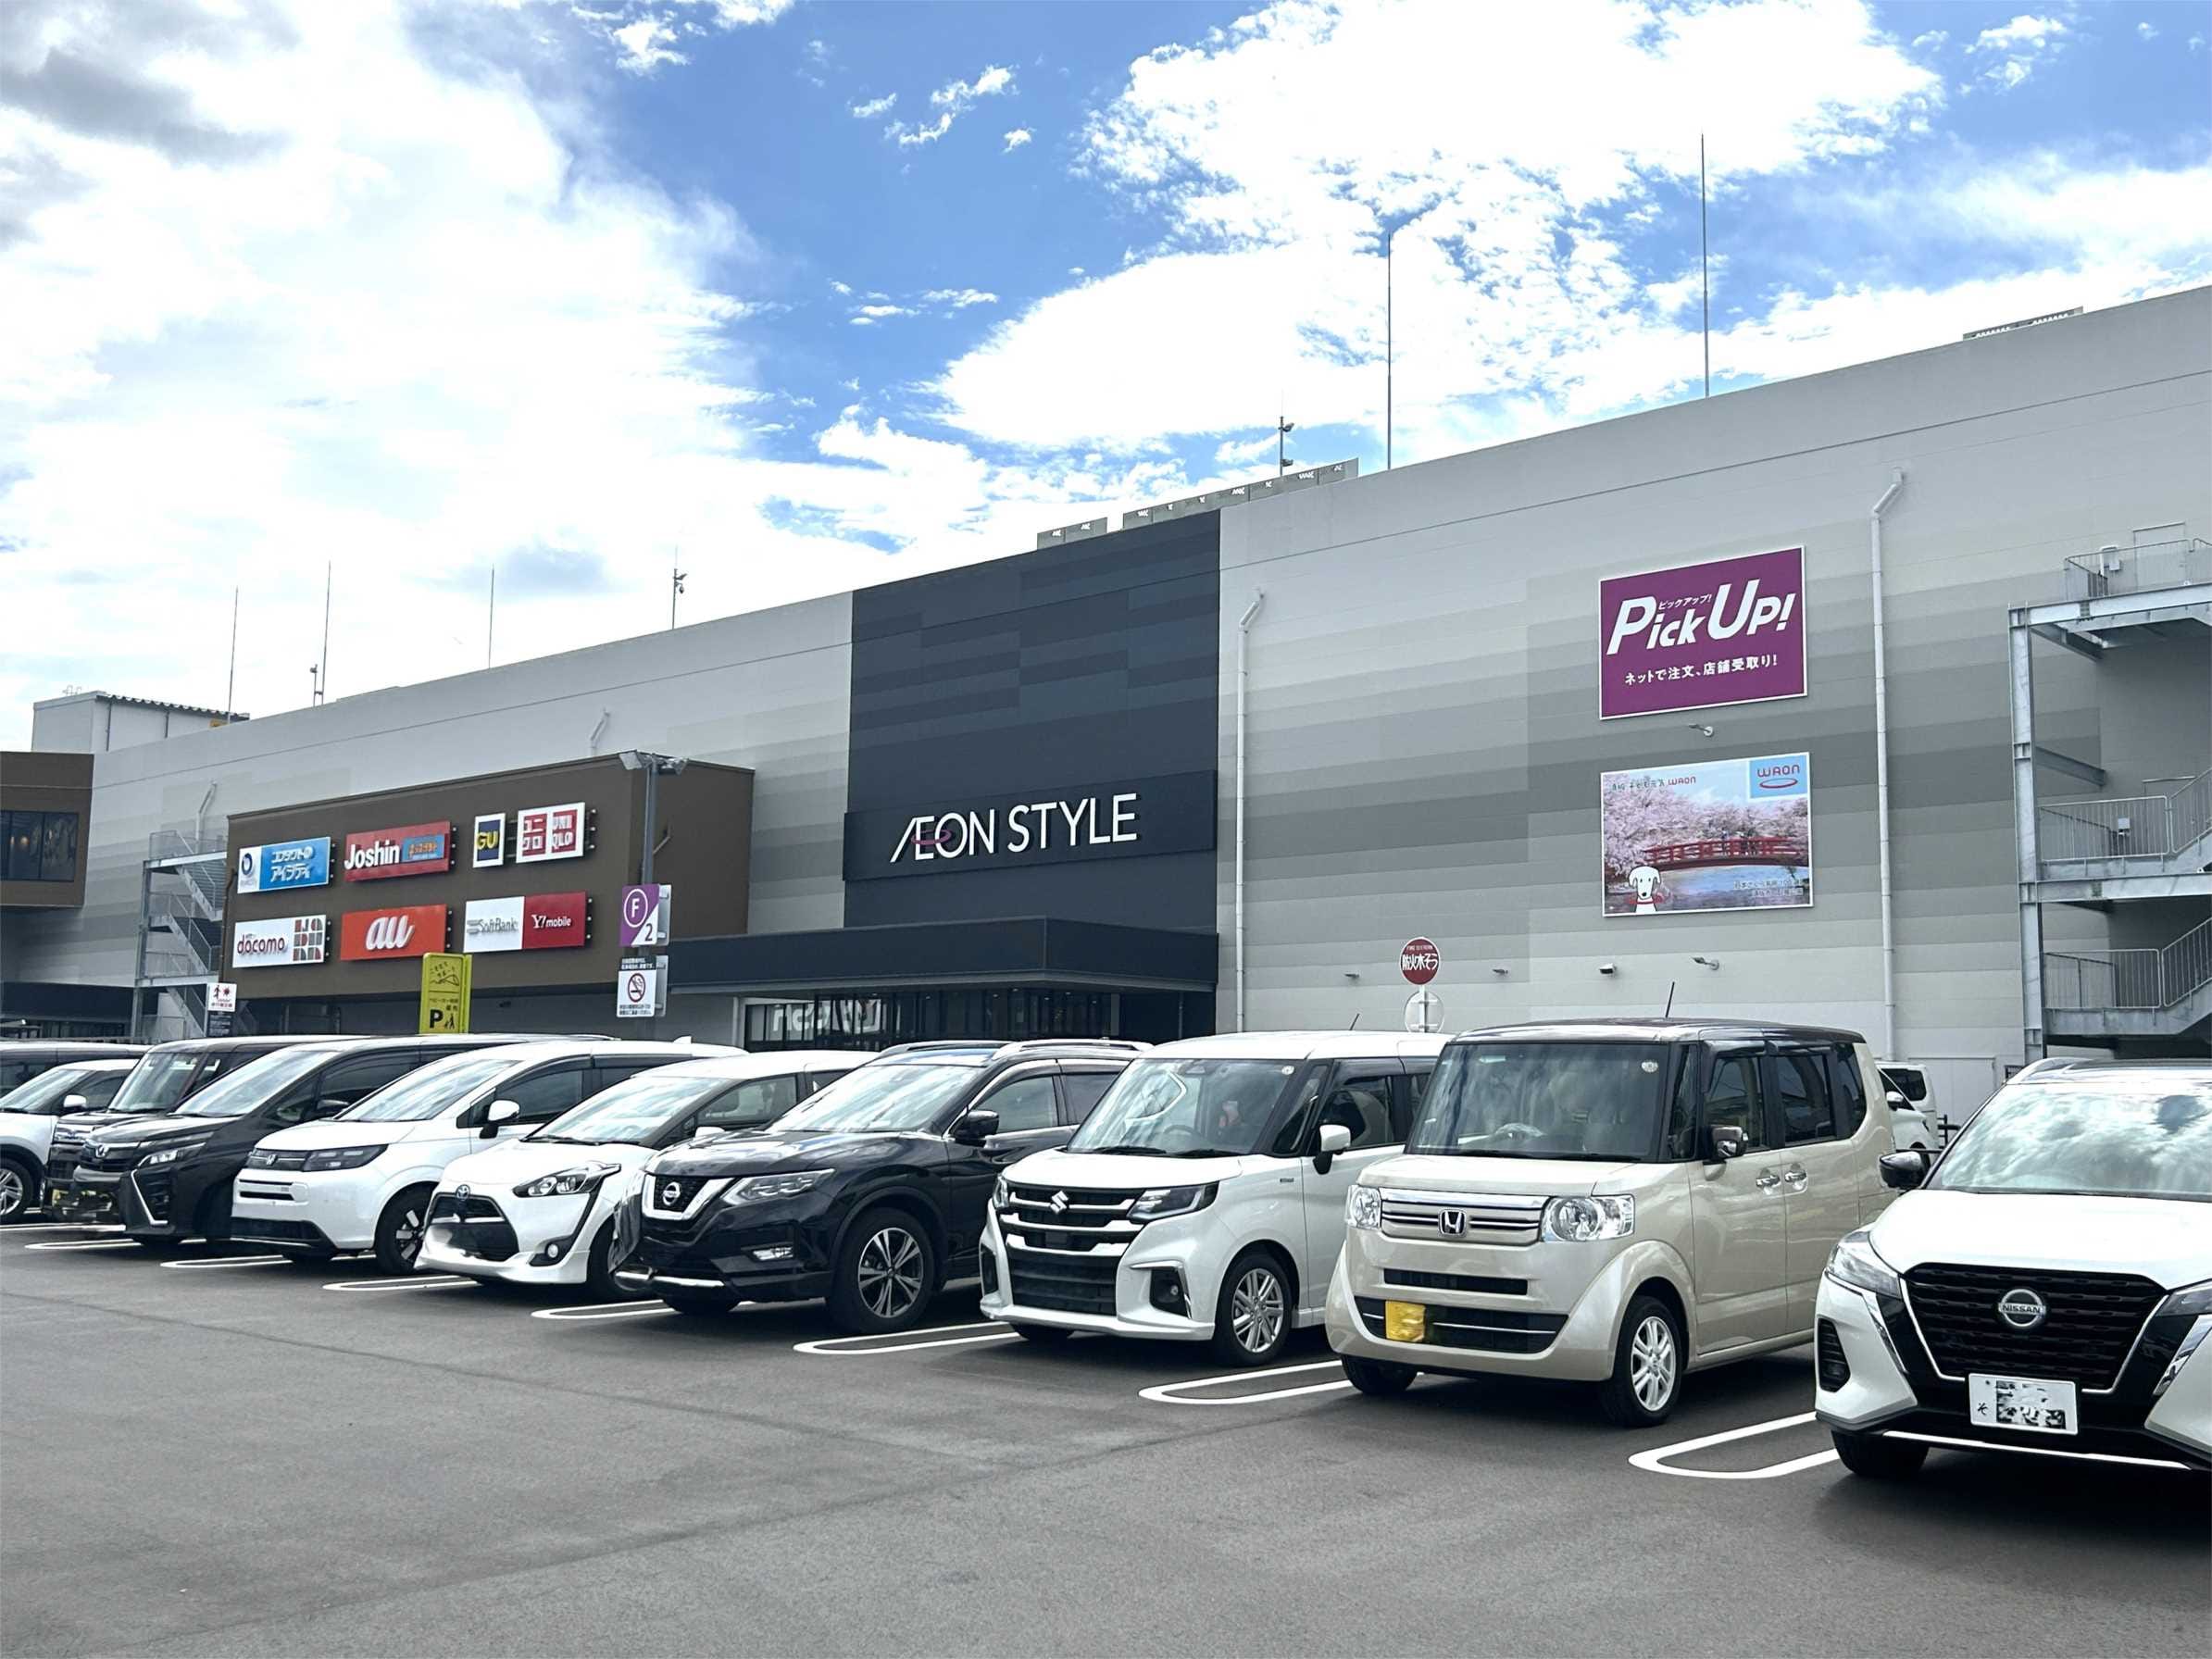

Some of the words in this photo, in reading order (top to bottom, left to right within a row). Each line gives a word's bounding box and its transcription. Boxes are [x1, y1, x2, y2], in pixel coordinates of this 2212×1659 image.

[1658, 593, 1712, 610] ピックアップ!
[1606, 596, 1706, 655] Pick
[1624, 654, 1778, 686] ネットで注文、店舗受取り!
[1668, 776, 1696, 786] WAON
[1757, 764, 1801, 778] WAON
[524, 817, 544, 834] ユニ
[1006, 792, 1138, 854] STYLE
[478, 830, 500, 850] GU
[523, 835, 544, 851] クロ
[344, 840, 401, 870] Joshin
[631, 898, 640, 918] F
[366, 915, 415, 951] au
[476, 917, 518, 934] SoftBank
[644, 922, 654, 942] 2
[237, 933, 286, 954] docomo
[430, 1008, 444, 1029] P
[2002, 1304, 2042, 1314] NISSAN
